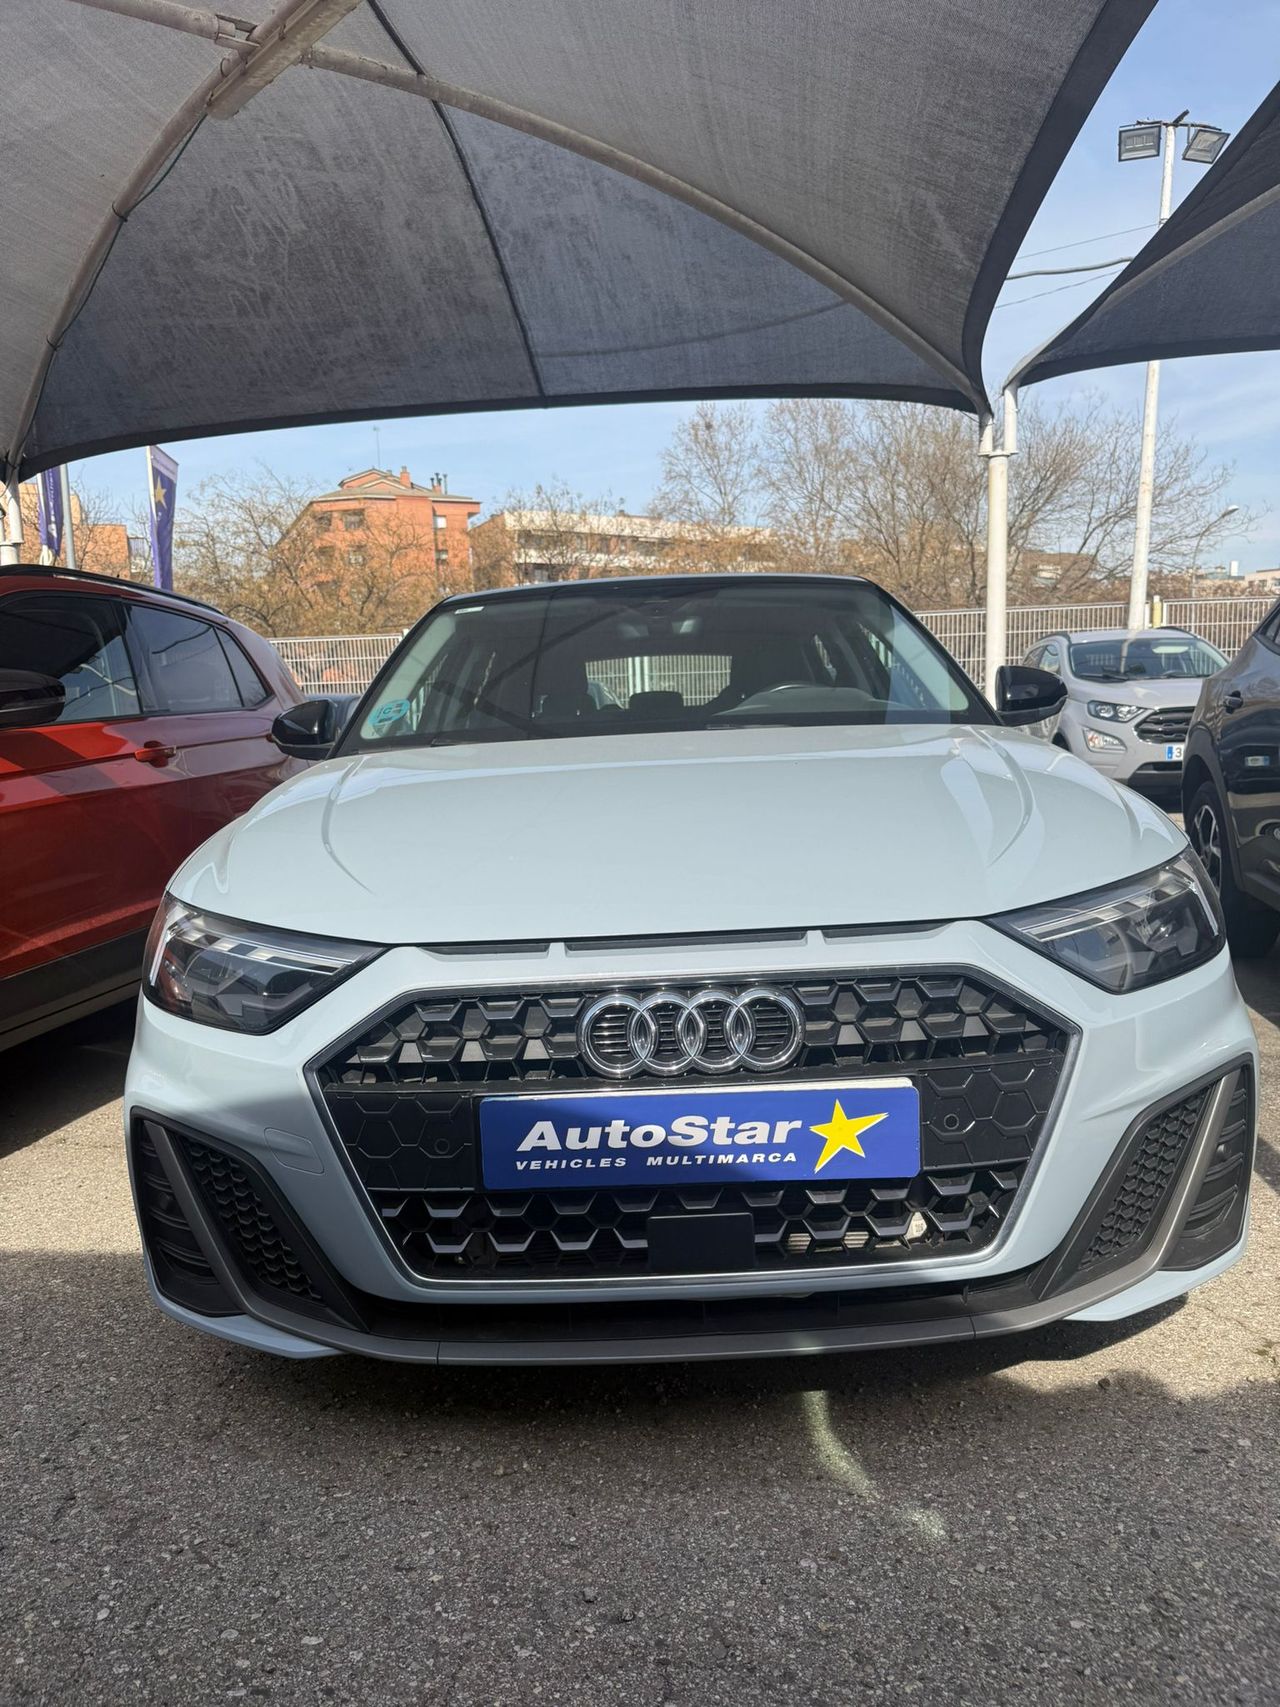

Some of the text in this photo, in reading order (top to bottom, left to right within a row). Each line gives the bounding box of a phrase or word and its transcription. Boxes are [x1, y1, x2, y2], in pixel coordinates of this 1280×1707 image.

[516, 1115, 802, 1152] AutoStar
[515, 1152, 797, 1171] VEHICLES MULTIMARCA
